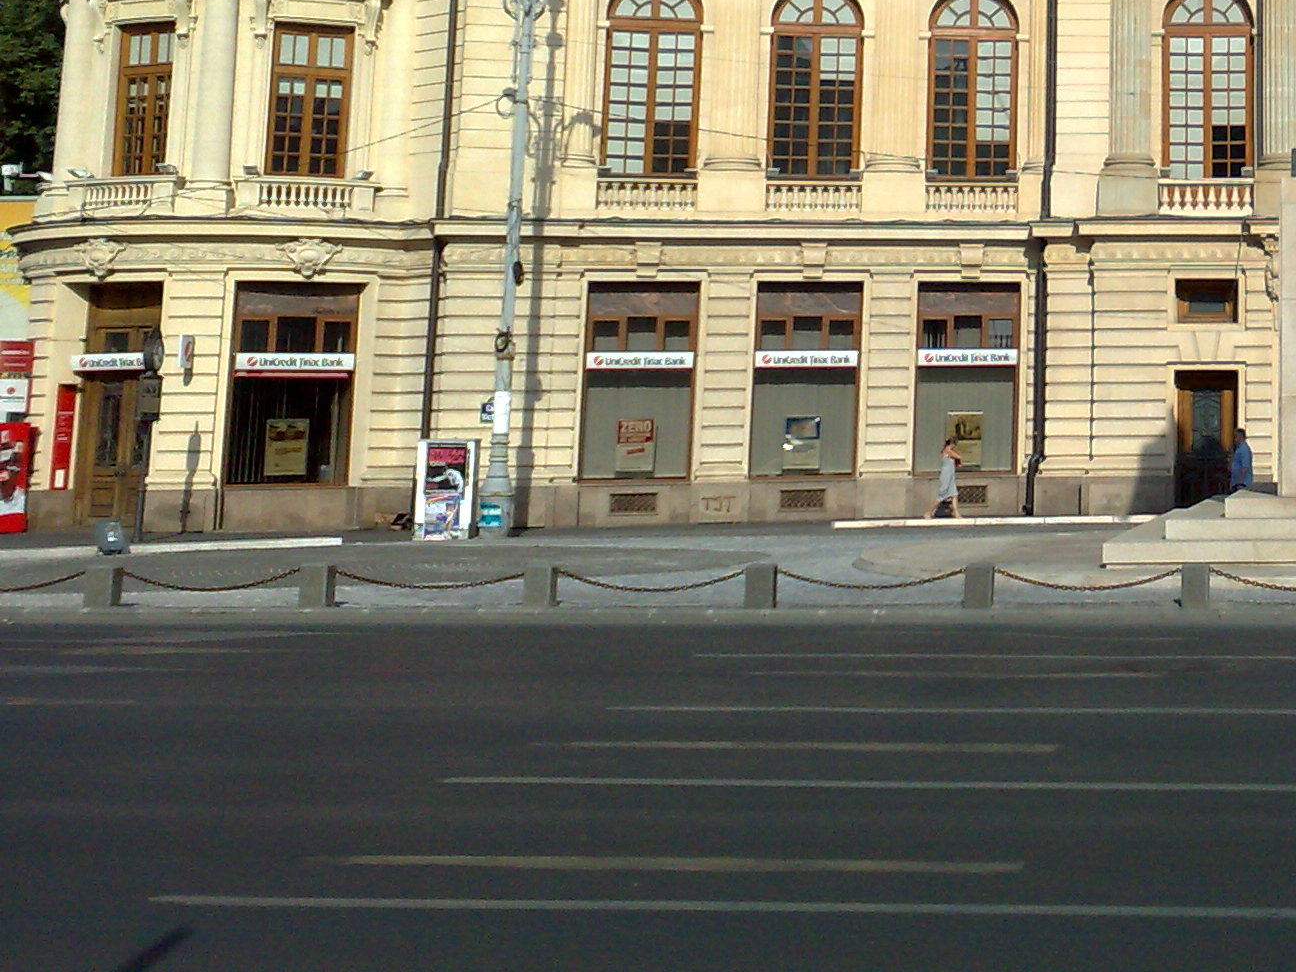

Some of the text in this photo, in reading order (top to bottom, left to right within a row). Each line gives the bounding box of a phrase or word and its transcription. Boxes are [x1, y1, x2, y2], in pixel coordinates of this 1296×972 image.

[259, 357, 297, 367] UniCredit
[321, 356, 344, 367] Bank
[605, 356, 642, 366] UniCredit
[664, 356, 687, 366] Bank
[773, 355, 808, 364] UniCredit
[830, 354, 850, 364] Bank
[935, 353, 969, 362] UniCredit
[990, 352, 1010, 362] Bank
